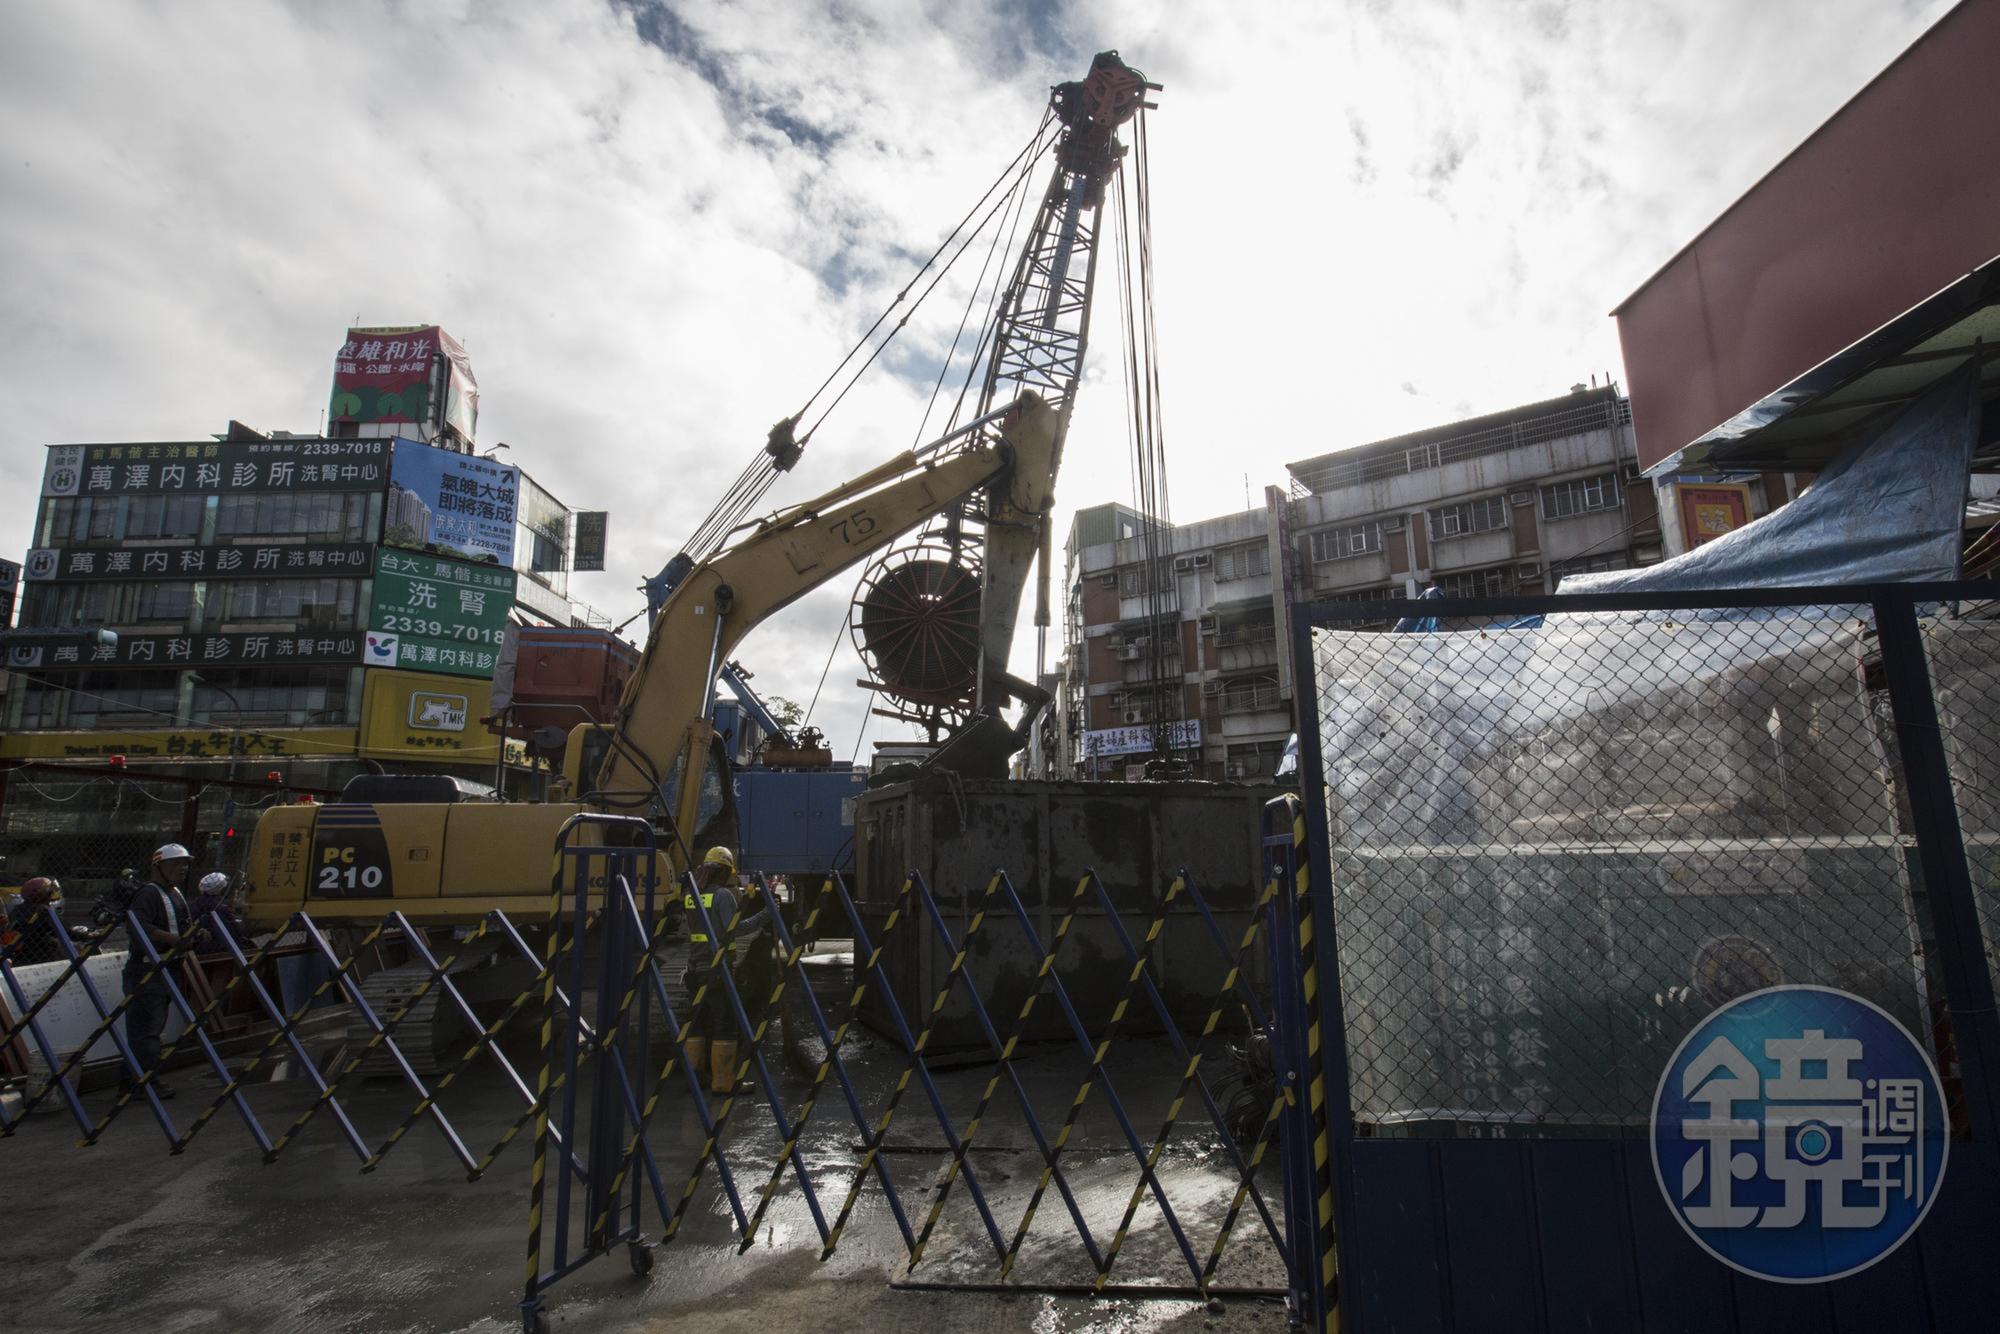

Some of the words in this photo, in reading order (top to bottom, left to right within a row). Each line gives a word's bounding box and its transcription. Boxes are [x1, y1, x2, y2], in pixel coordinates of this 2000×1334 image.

[303, 442, 382, 455] 2339-7018
[300, 463, 379, 482] 洗腎中心
[438, 491, 513, 524] 即將落成
[287, 549, 366, 567] 洗腎中心
[407, 580, 486, 616] 洗腎
[382, 614, 505, 645] 2339-7018
[275, 636, 355, 657] 洗腎中心
[441, 710, 464, 725] TMK
[323, 847, 355, 863] PC
[318, 866, 383, 889] 210
